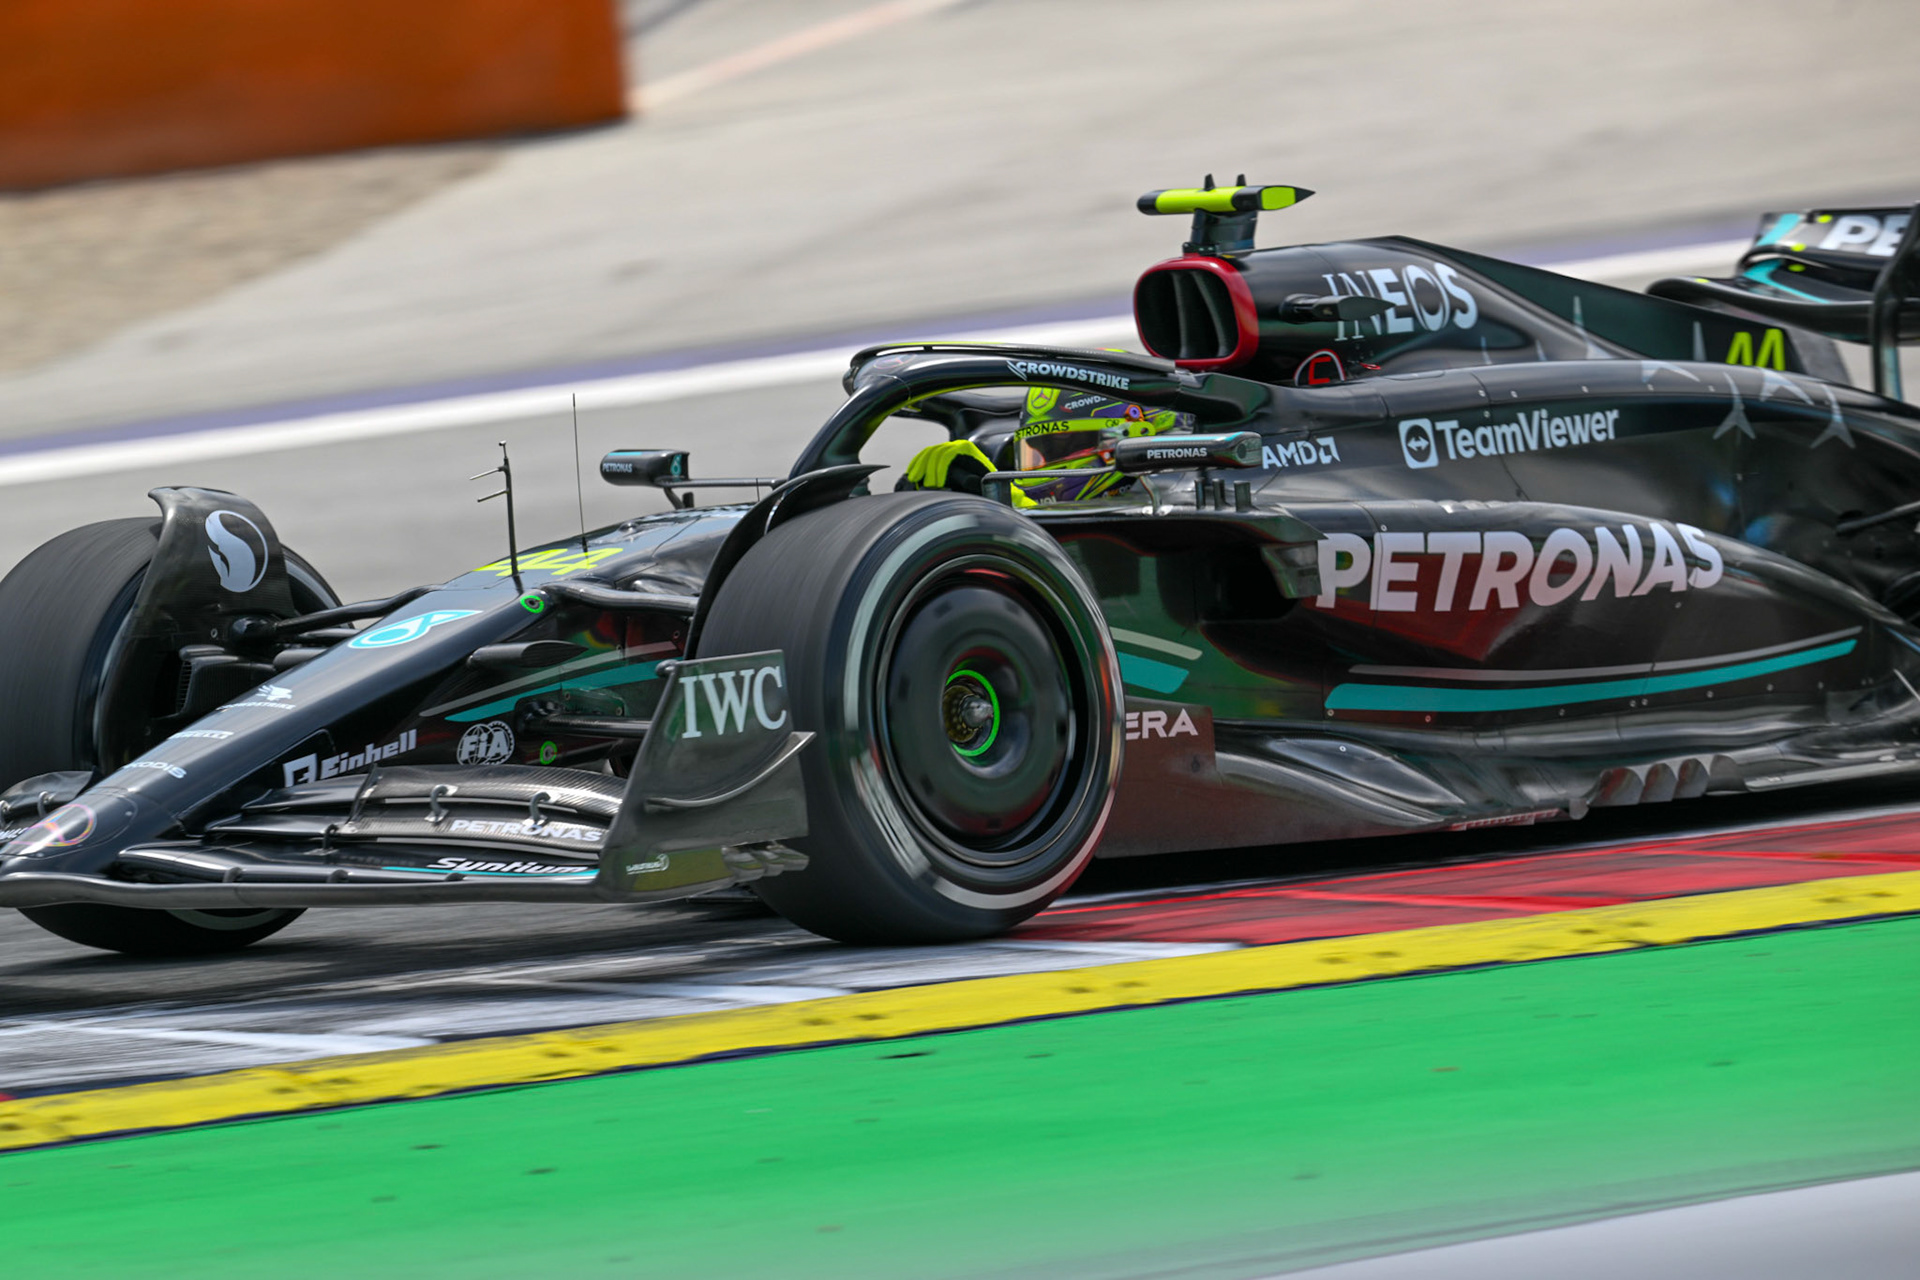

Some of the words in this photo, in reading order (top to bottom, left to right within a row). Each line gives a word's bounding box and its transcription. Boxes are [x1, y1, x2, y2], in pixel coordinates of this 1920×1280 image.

[1322, 262, 1478, 341] INEOS
[1014, 361, 1130, 390] CROWDSTRIKE
[1014, 421, 1070, 439] ETRONAS
[1435, 409, 1620, 460] TeamViewer
[1146, 446, 1208, 459] PETRONAS
[1262, 440, 1318, 470] AMD
[602, 462, 633, 473] PETRONAS
[472, 548, 623, 577] 44
[1315, 523, 1724, 612] PETRONAS
[679, 666, 787, 739] IWC
[320, 729, 417, 780] Einhell
[450, 819, 602, 842] PETRONAS
